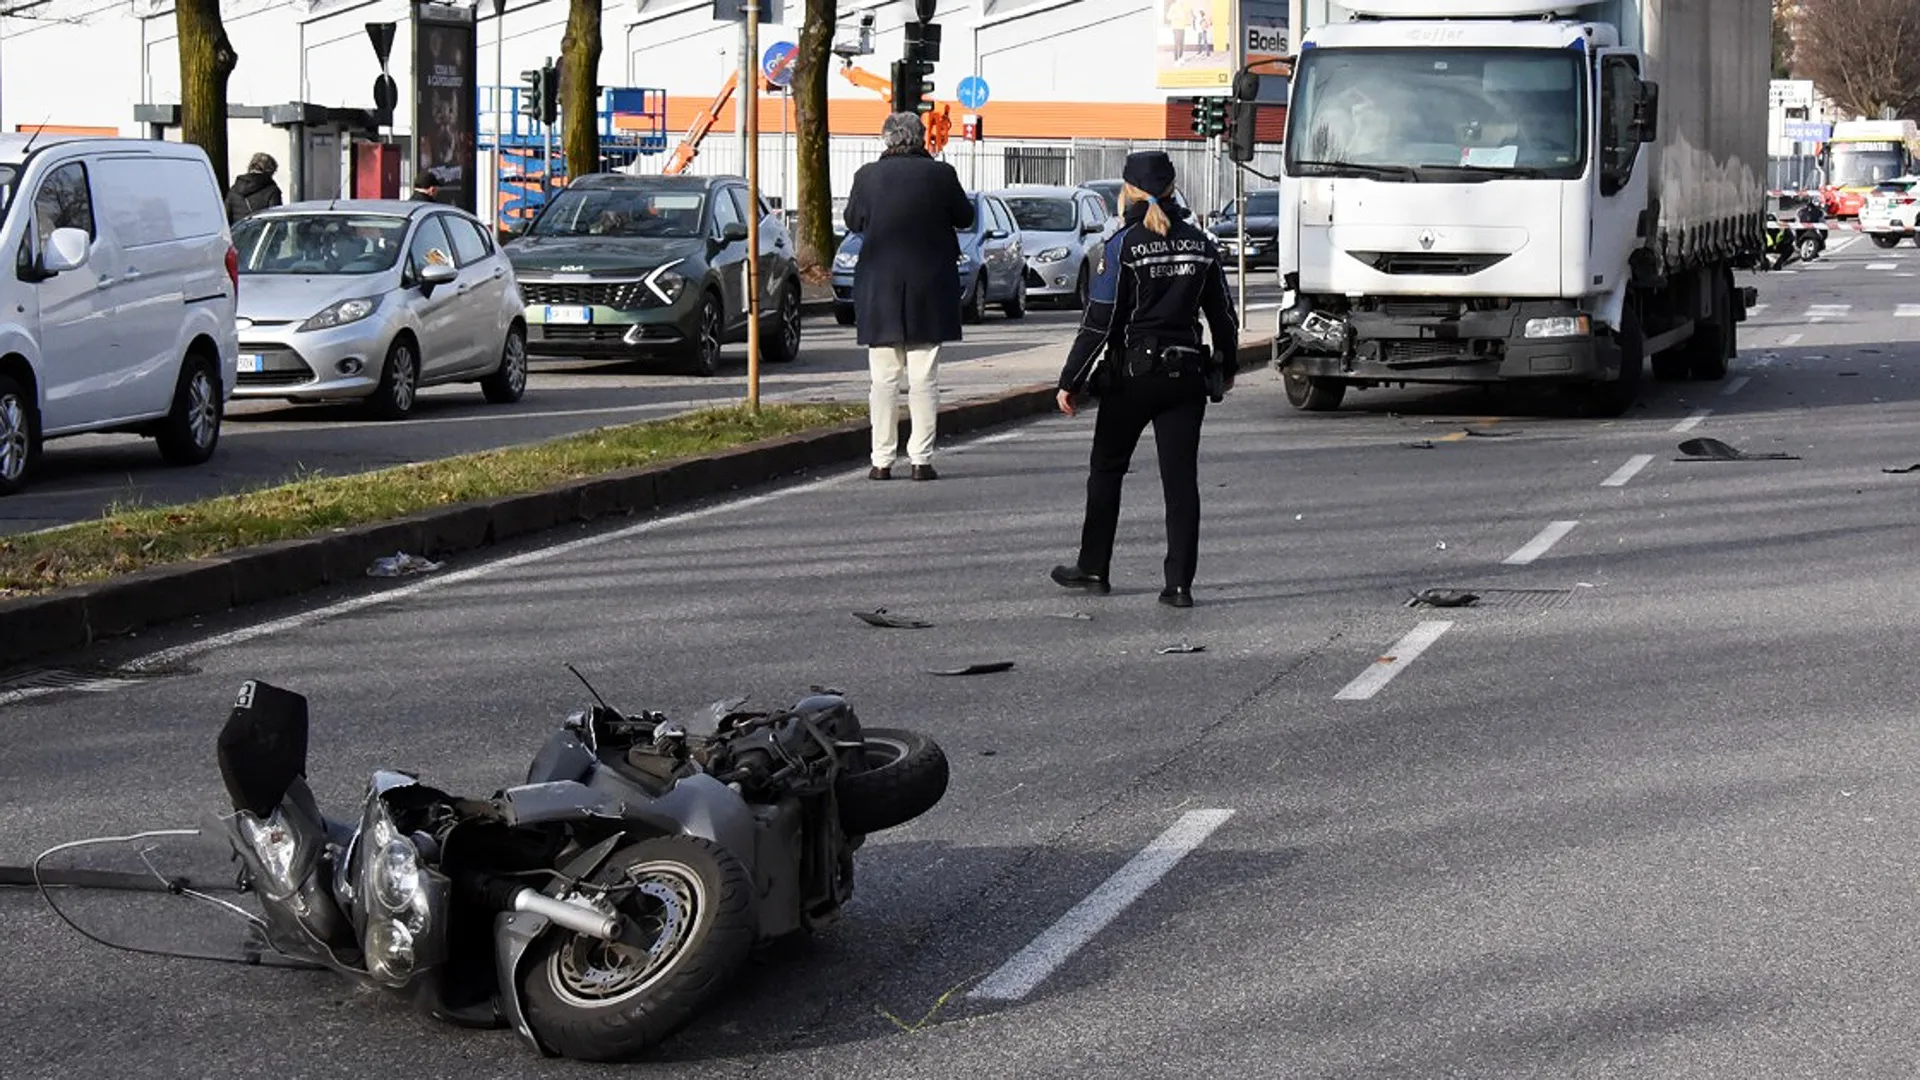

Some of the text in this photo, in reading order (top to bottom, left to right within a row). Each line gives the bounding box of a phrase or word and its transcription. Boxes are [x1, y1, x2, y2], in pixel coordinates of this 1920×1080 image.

[1248, 29, 1288, 52] Boels
[1131, 239, 1205, 256] POLIZIA LOCALE
[1150, 264, 1195, 277] BERGAMO
